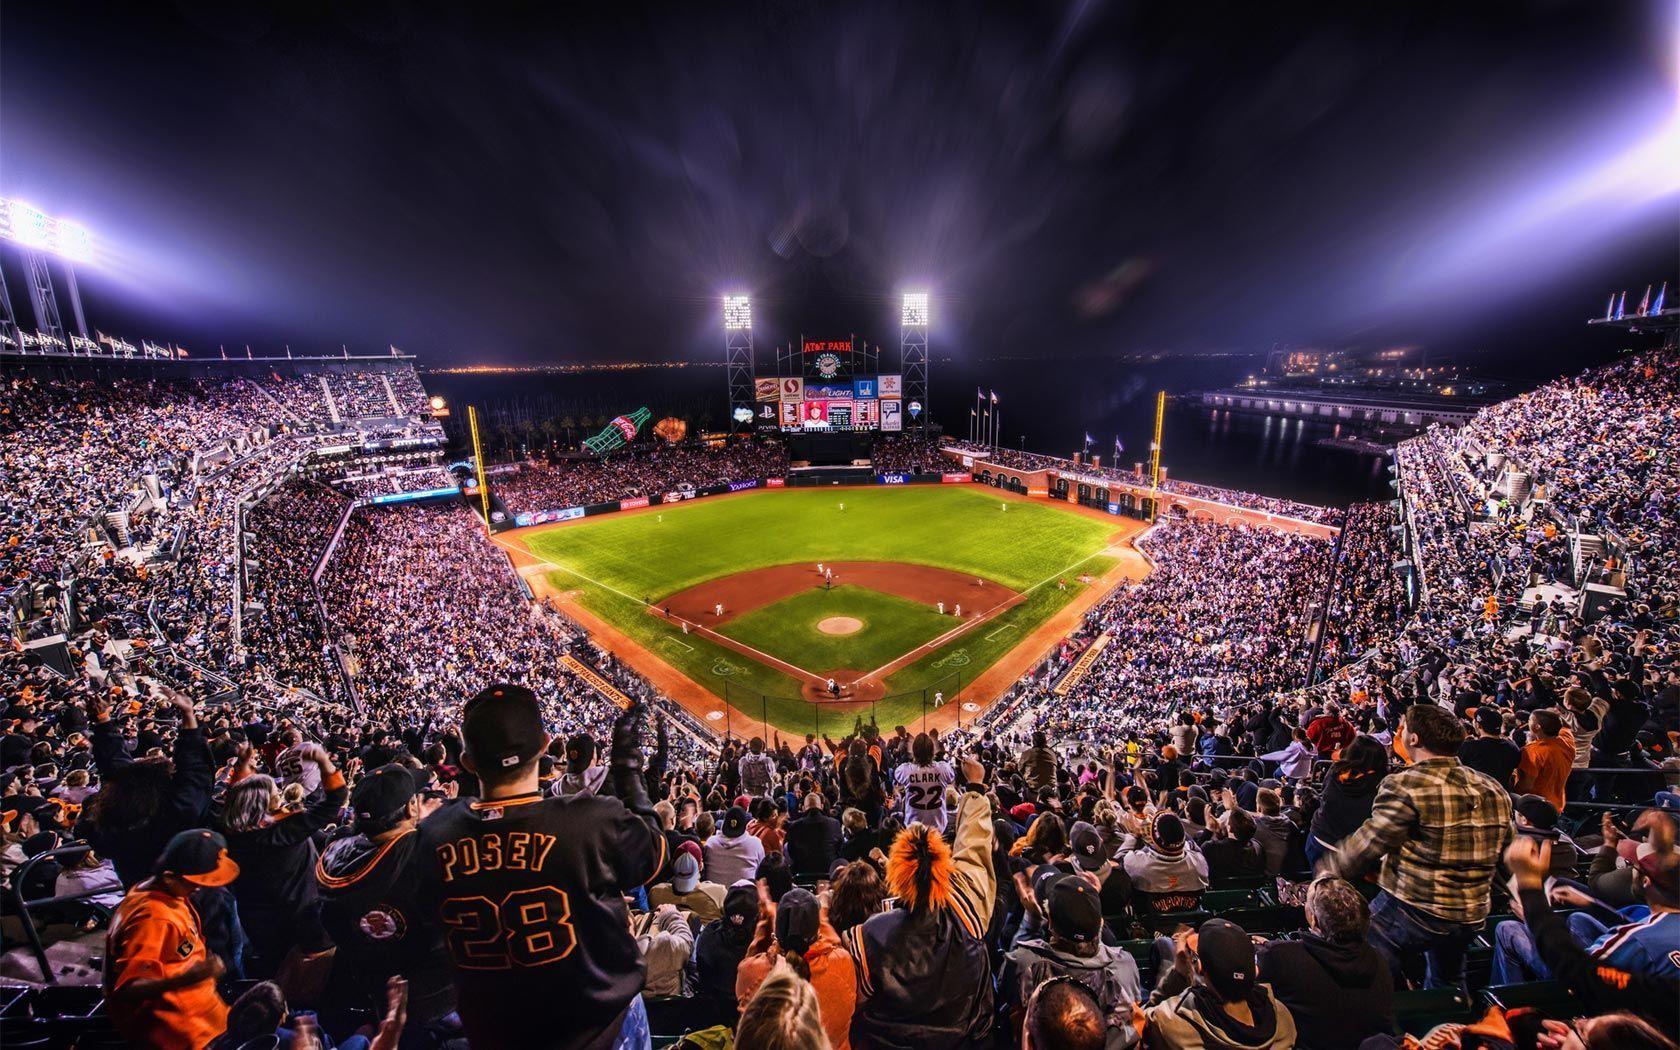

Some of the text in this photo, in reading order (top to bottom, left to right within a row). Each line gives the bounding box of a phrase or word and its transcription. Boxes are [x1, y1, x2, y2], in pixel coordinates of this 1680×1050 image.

[804, 341, 851, 352] AT&T PARK
[883, 475, 904, 484] VISA
[1077, 475, 1109, 487] LANDING
[909, 773, 941, 783] CLARK
[909, 785, 943, 810] 22
[436, 832, 556, 882] POSEY
[440, 885, 577, 970] 28
